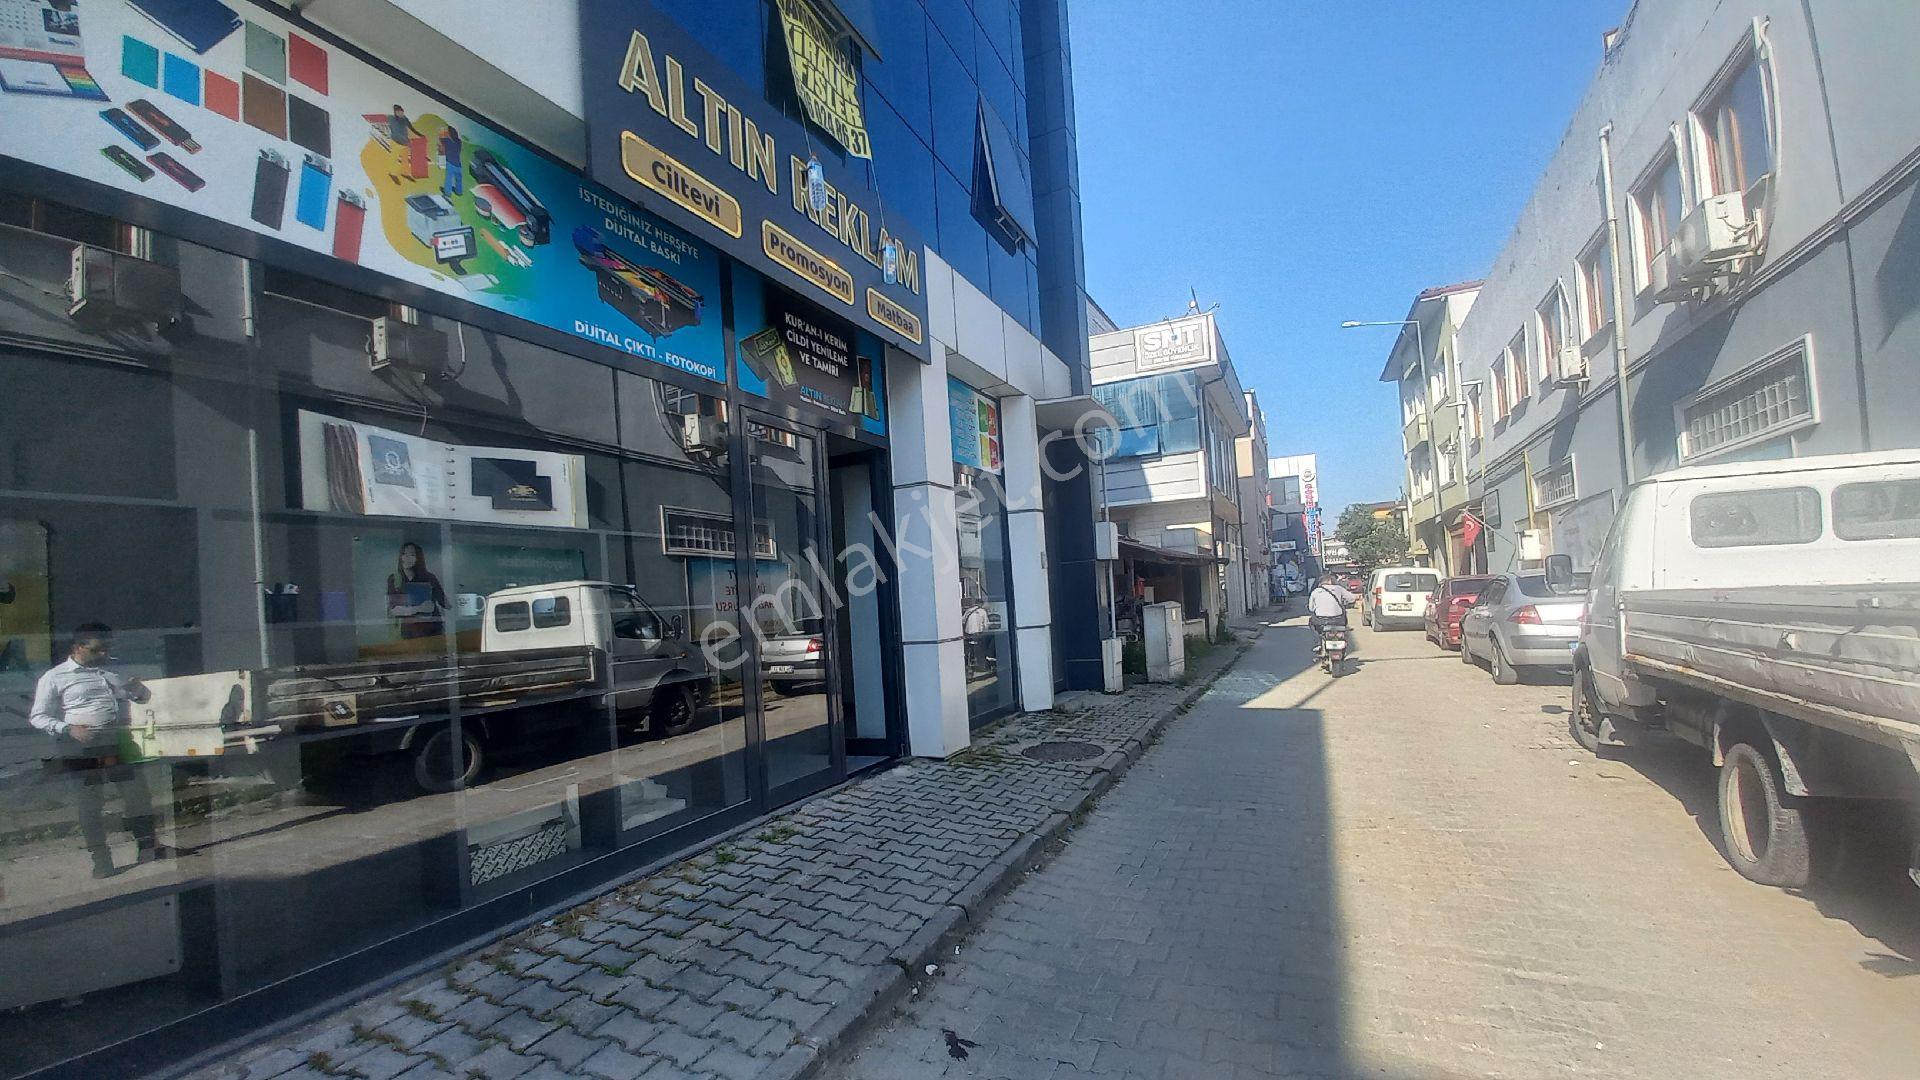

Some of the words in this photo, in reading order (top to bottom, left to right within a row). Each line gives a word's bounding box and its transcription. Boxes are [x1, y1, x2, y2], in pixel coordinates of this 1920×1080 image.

[618, 28, 778, 195] ALTIN
[651, 160, 721, 219] Ciltevi
[769, 231, 850, 296] Promosyon
[876, 299, 915, 334] Matbaa
[574, 319, 622, 347] DİJİTAL
[624, 337, 656, 360] ÇIKTI
[665, 352, 716, 379] FOTOKOPİ
[786, 329, 810, 350] CİLDİ
[810, 340, 849, 367] YENİLEME
[798, 350, 811, 366] VE
[811, 355, 839, 377] TAMİRİ
[824, 331, 849, 352] KERİM
